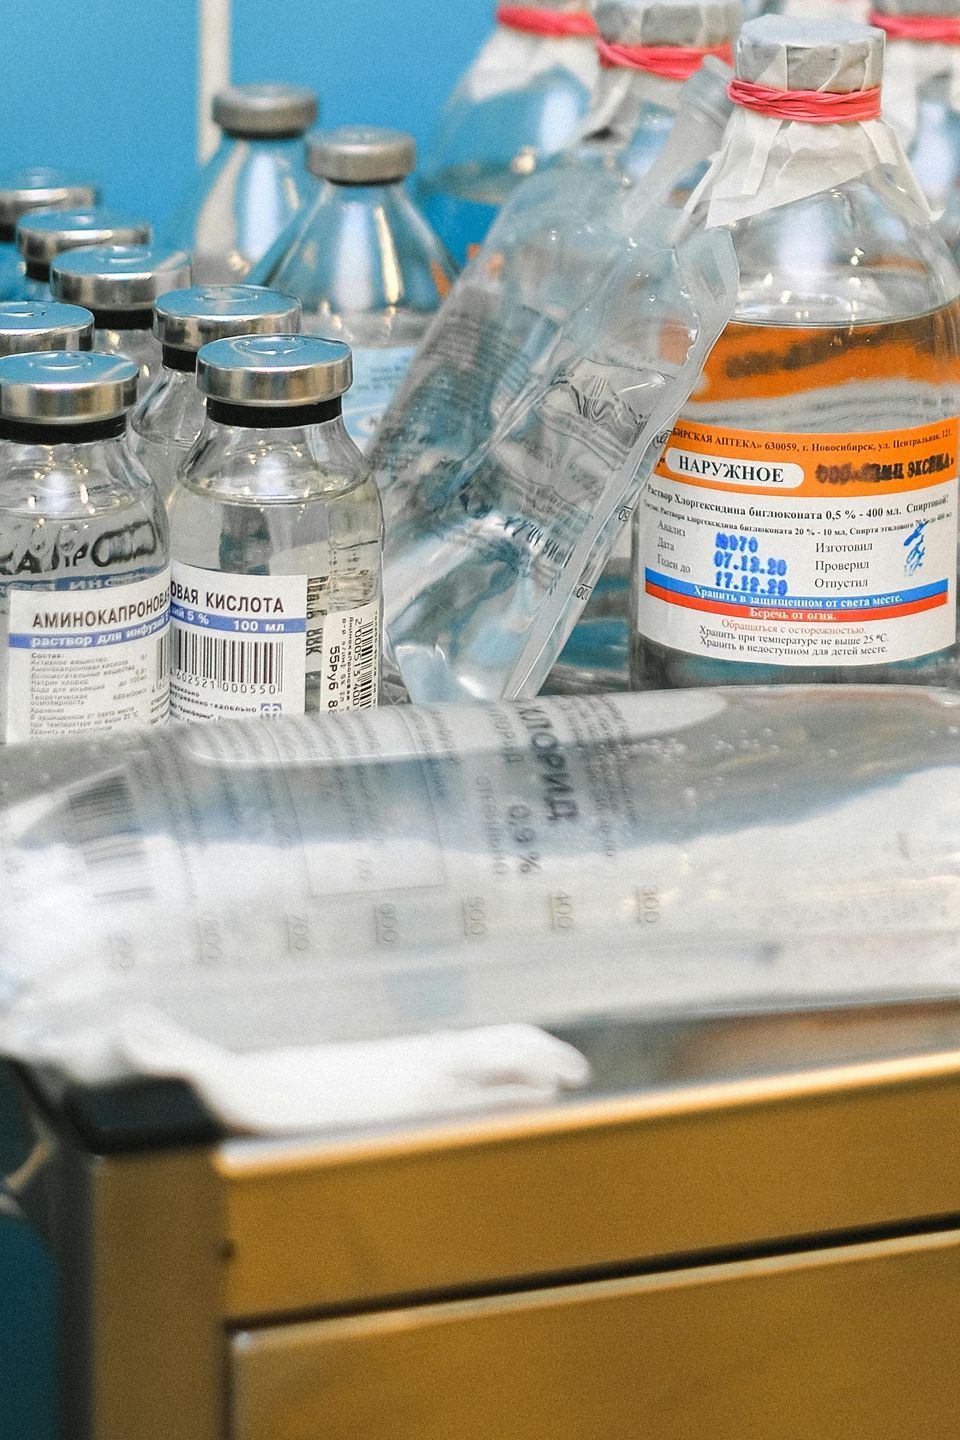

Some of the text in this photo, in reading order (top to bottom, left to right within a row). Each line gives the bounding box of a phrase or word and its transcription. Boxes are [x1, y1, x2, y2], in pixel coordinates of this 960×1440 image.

[673, 427, 712, 443] БИРСКАЯ
[715, 435, 761, 449] АПТЕКА»
[764, 441, 800, 452] 630059,
[811, 441, 876, 453] Новосибирск,
[877, 443, 891, 451] ул.
[679, 455, 784, 483] НАРУЖНОЕ
[674, 493, 746, 516] Хлоргексидина
[749, 506, 823, 520] биглюконата
[825, 510, 842, 521] 0,5
[844, 509, 856, 520] %
[866, 508, 884, 518] 400
[885, 507, 902, 516] мл.
[658, 521, 686, 537] Анализ
[739, 523, 793, 535] биглюконата
[794, 527, 804, 535] 20
[806, 528, 815, 536] %
[823, 528, 832, 536] 10
[849, 526, 879, 537] Спирта
[657, 537, 788, 577] Дата 07.12.20
[815, 542, 873, 553] Изготовил
[657, 554, 789, 596] Годен до 17.12.20
[814, 560, 870, 573] Проверил
[814, 577, 868, 590] Отпустил
[170, 580, 284, 613] ОВАЯ КИСЛОТА
[694, 585, 737, 603] Хранить
[749, 597, 823, 608] защищенном
[840, 598, 870, 607] света
[872, 595, 903, 605] месте.
[187, 610, 195, 621] 5
[198, 613, 210, 625] %
[234, 620, 259, 631] 100
[264, 622, 285, 632] мл
[354, 617, 363, 625] 2
[750, 607, 837, 621] Беречь от огня.
[699, 625, 736, 640] Хранить
[738, 633, 756, 643] при
[758, 636, 818, 647] температуре
[834, 637, 861, 645] выше
[862, 635, 874, 644] 25
[721, 618, 778, 633] Обращаться
[788, 625, 866, 636] осторожностью.
[31, 635, 93, 648] раствор
[97, 631, 122, 645] для
[699, 636, 737, 650] Хранить
[747, 644, 809, 657] недоступном
[811, 648, 829, 656] для
[830, 647, 858, 656] детей
[860, 645, 888, 654] месте.
[176, 669, 215, 689] 602521
[222, 681, 276, 695] 000550
[508, 804, 536, 844] 0,9
[518, 850, 544, 875] %
[554, 891, 574, 929] 400
